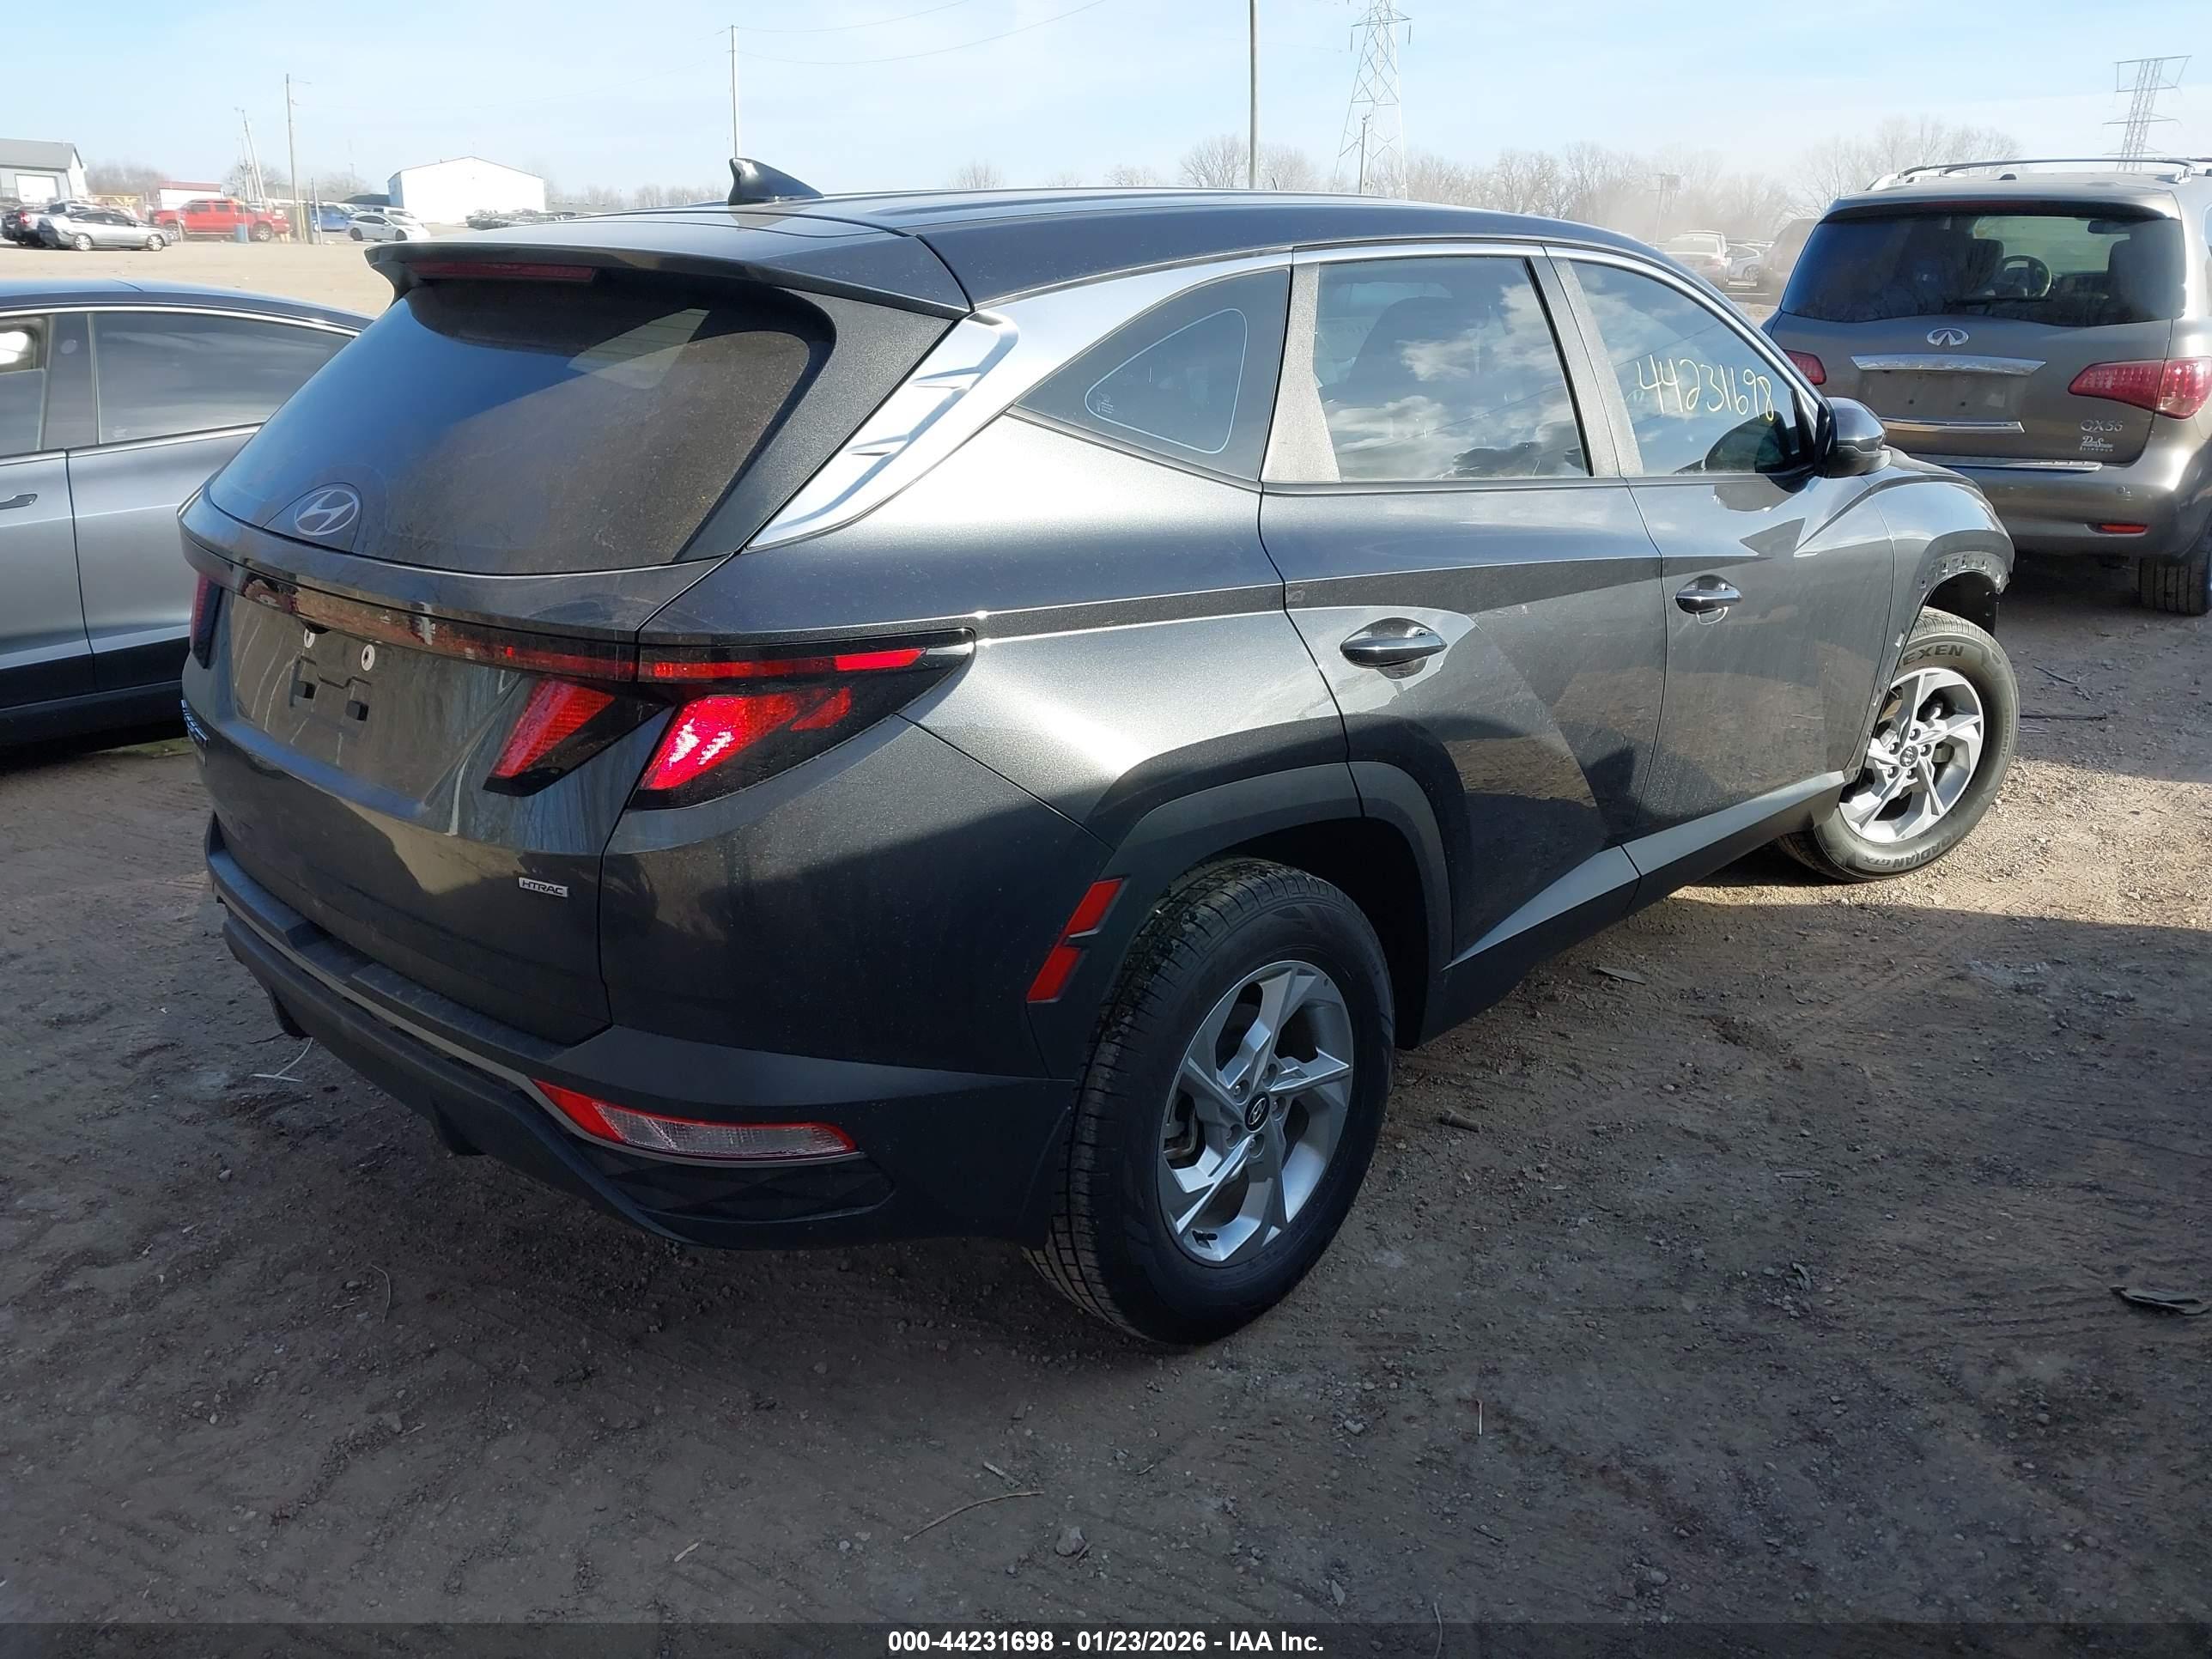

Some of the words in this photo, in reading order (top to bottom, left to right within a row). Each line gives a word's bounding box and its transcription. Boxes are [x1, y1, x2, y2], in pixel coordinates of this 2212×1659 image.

[1637, 354, 1775, 422] 44231698
[1899, 644, 1964, 670] EXEN
[521, 879, 564, 896] HTRAC
